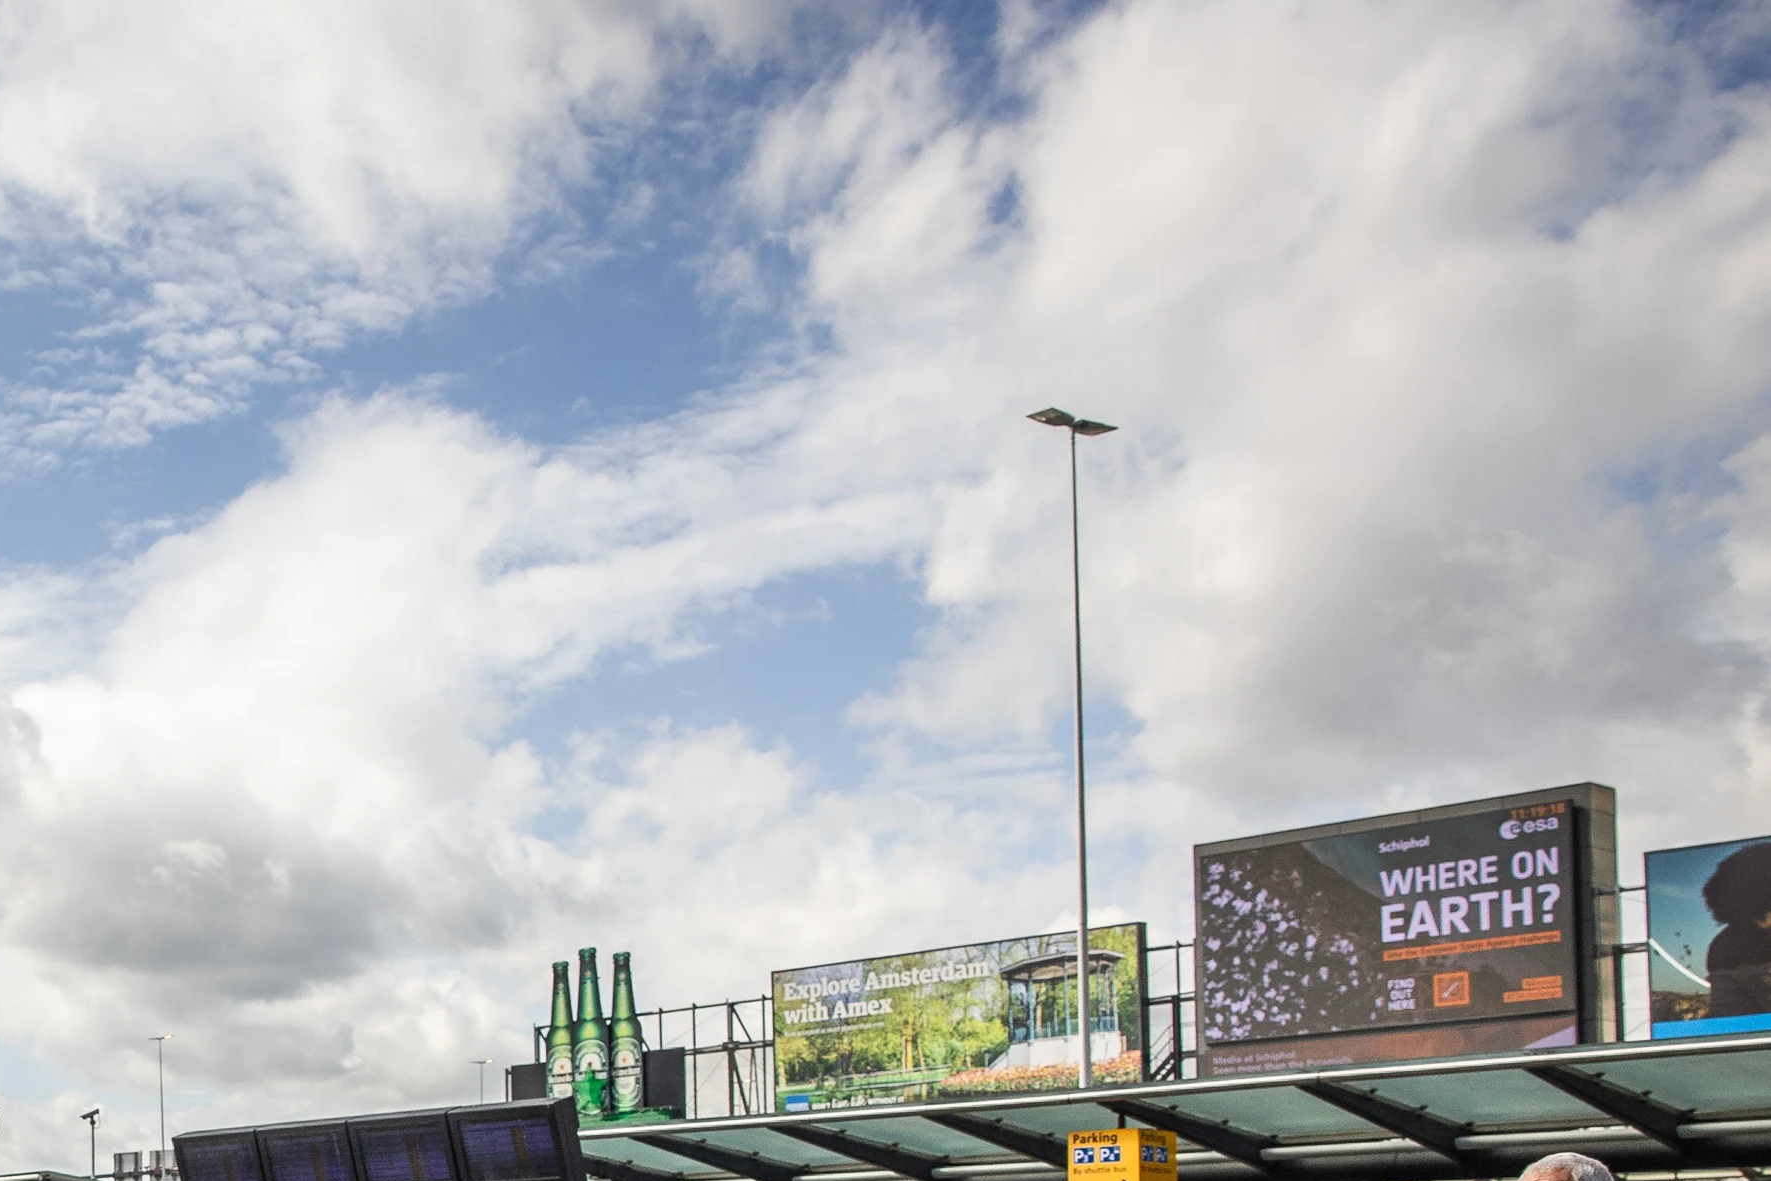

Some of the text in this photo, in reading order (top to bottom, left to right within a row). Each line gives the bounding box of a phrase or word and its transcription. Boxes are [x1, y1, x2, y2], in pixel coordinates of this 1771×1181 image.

[1522, 816, 1559, 833] esa
[1379, 835, 1430, 853] Schiphol
[1380, 846, 1559, 897] WHERE ON
[1381, 883, 1561, 943] EARTH?
[783, 961, 990, 1000] Explore Amsterdam
[1387, 977, 1416, 990] FIND
[1389, 989, 1414, 1001] OUT
[784, 997, 893, 1024] with Amex
[1387, 998, 1416, 1011] HERE
[1072, 1132, 1118, 1145] Parking
